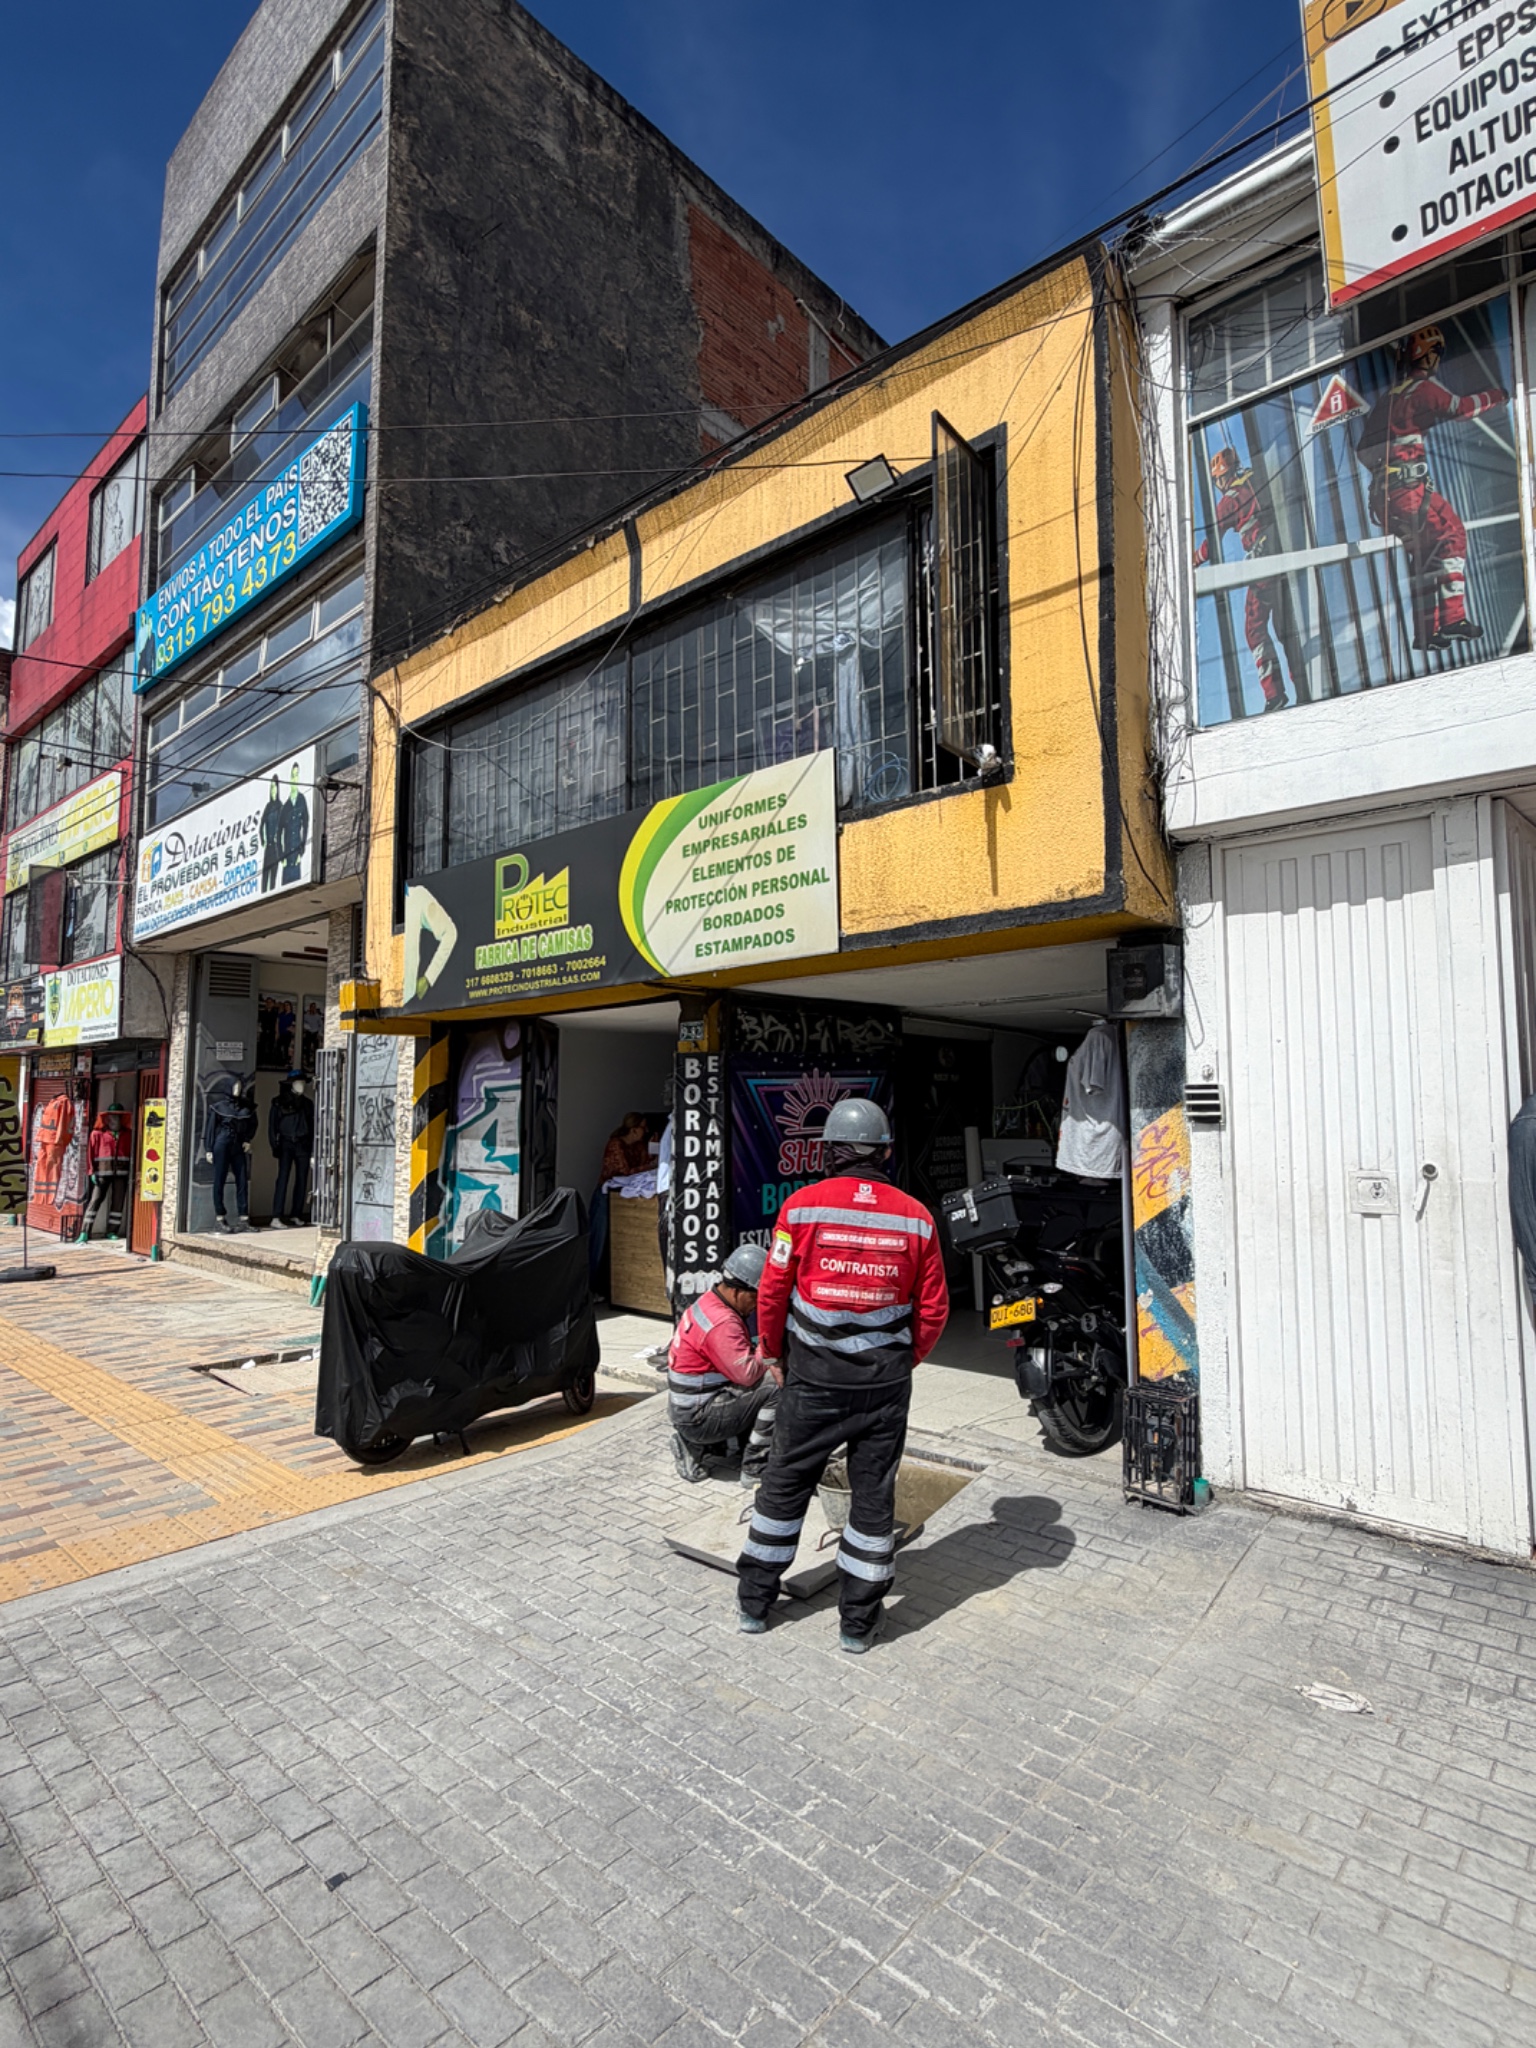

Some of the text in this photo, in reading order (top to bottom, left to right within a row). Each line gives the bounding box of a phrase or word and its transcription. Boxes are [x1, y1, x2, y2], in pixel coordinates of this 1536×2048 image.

[1457, 0, 1536, 71] EPPS
[1414, 46, 1536, 143] EQUIPOS
[157, 498, 297, 638] CONTACTENOS
[158, 560, 196, 611] ENVIOS
[198, 556, 206, 571] A
[209, 516, 243, 560] TODO
[246, 503, 262, 531] EL
[165, 531, 297, 664] 315 793 4373
[682, 814, 808, 858] EMPRESARIALES
[698, 793, 787, 830] UNIFORMES
[165, 810, 261, 871] Dotaciones
[692, 845, 796, 883] ELEMENTOS DE
[138, 887, 148, 904] EL
[150, 852, 219, 897] PROVEEDOR
[665, 867, 830, 915] PROTECCIÓN PERSONAL
[497, 914, 567, 936] Industrial
[695, 928, 795, 958] ESTAMPADOS
[703, 904, 785, 932] BORDADOS
[475, 924, 593, 970] FABRICA DE CAMISAS
[683, 1058, 701, 1264] BORDADOS
[705, 1055, 720, 1264] ESTAMPADOS
[820, 1258, 898, 1277] CONTRATISTA
